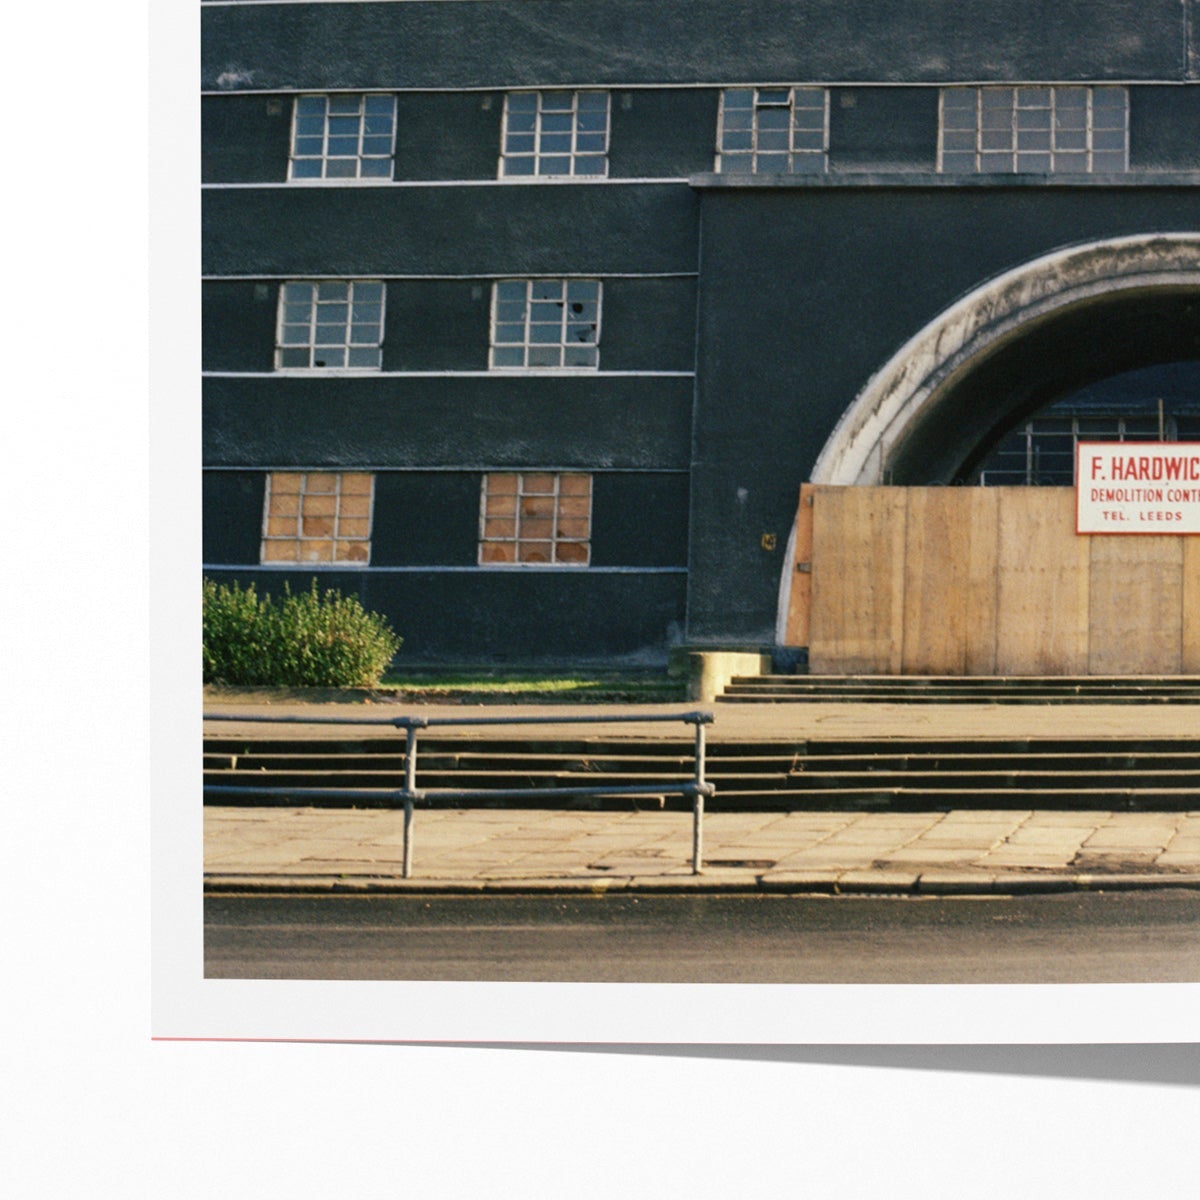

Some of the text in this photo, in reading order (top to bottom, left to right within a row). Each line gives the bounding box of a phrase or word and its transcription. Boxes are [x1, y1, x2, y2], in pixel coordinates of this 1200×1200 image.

[1091, 456, 1105, 481] F.
[1091, 488, 1163, 502] DEMOLITION
[1102, 511, 1182, 521] TEL. LEEDS
